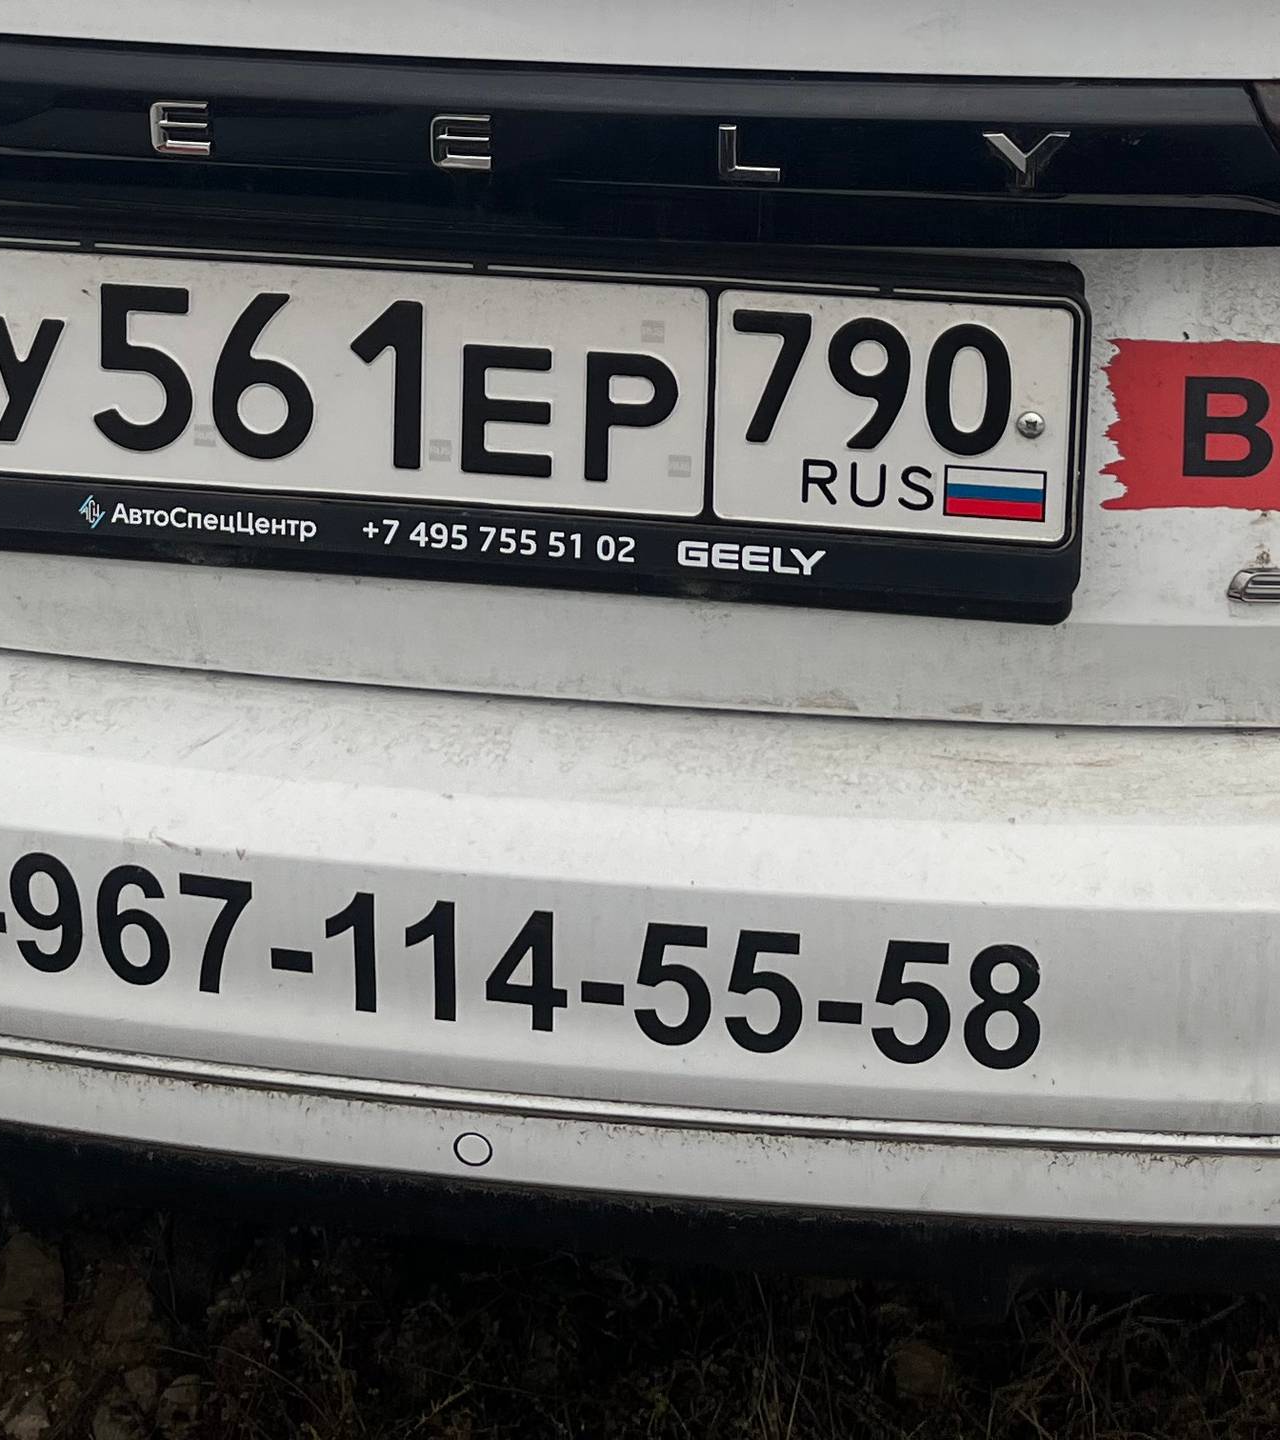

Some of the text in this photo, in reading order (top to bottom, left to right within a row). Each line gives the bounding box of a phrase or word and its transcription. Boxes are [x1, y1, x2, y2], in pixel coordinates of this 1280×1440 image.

[732, 308, 1012, 456] 790
[801, 458, 934, 511] RUS
[111, 502, 317, 542] АвтоСпецЦентр
[362, 519, 400, 545] +7
[409, 521, 469, 550] 495
[479, 526, 537, 556] 755
[548, 531, 582, 559] 51
[596, 535, 636, 563] 02
[677, 539, 827, 576] GEELY
